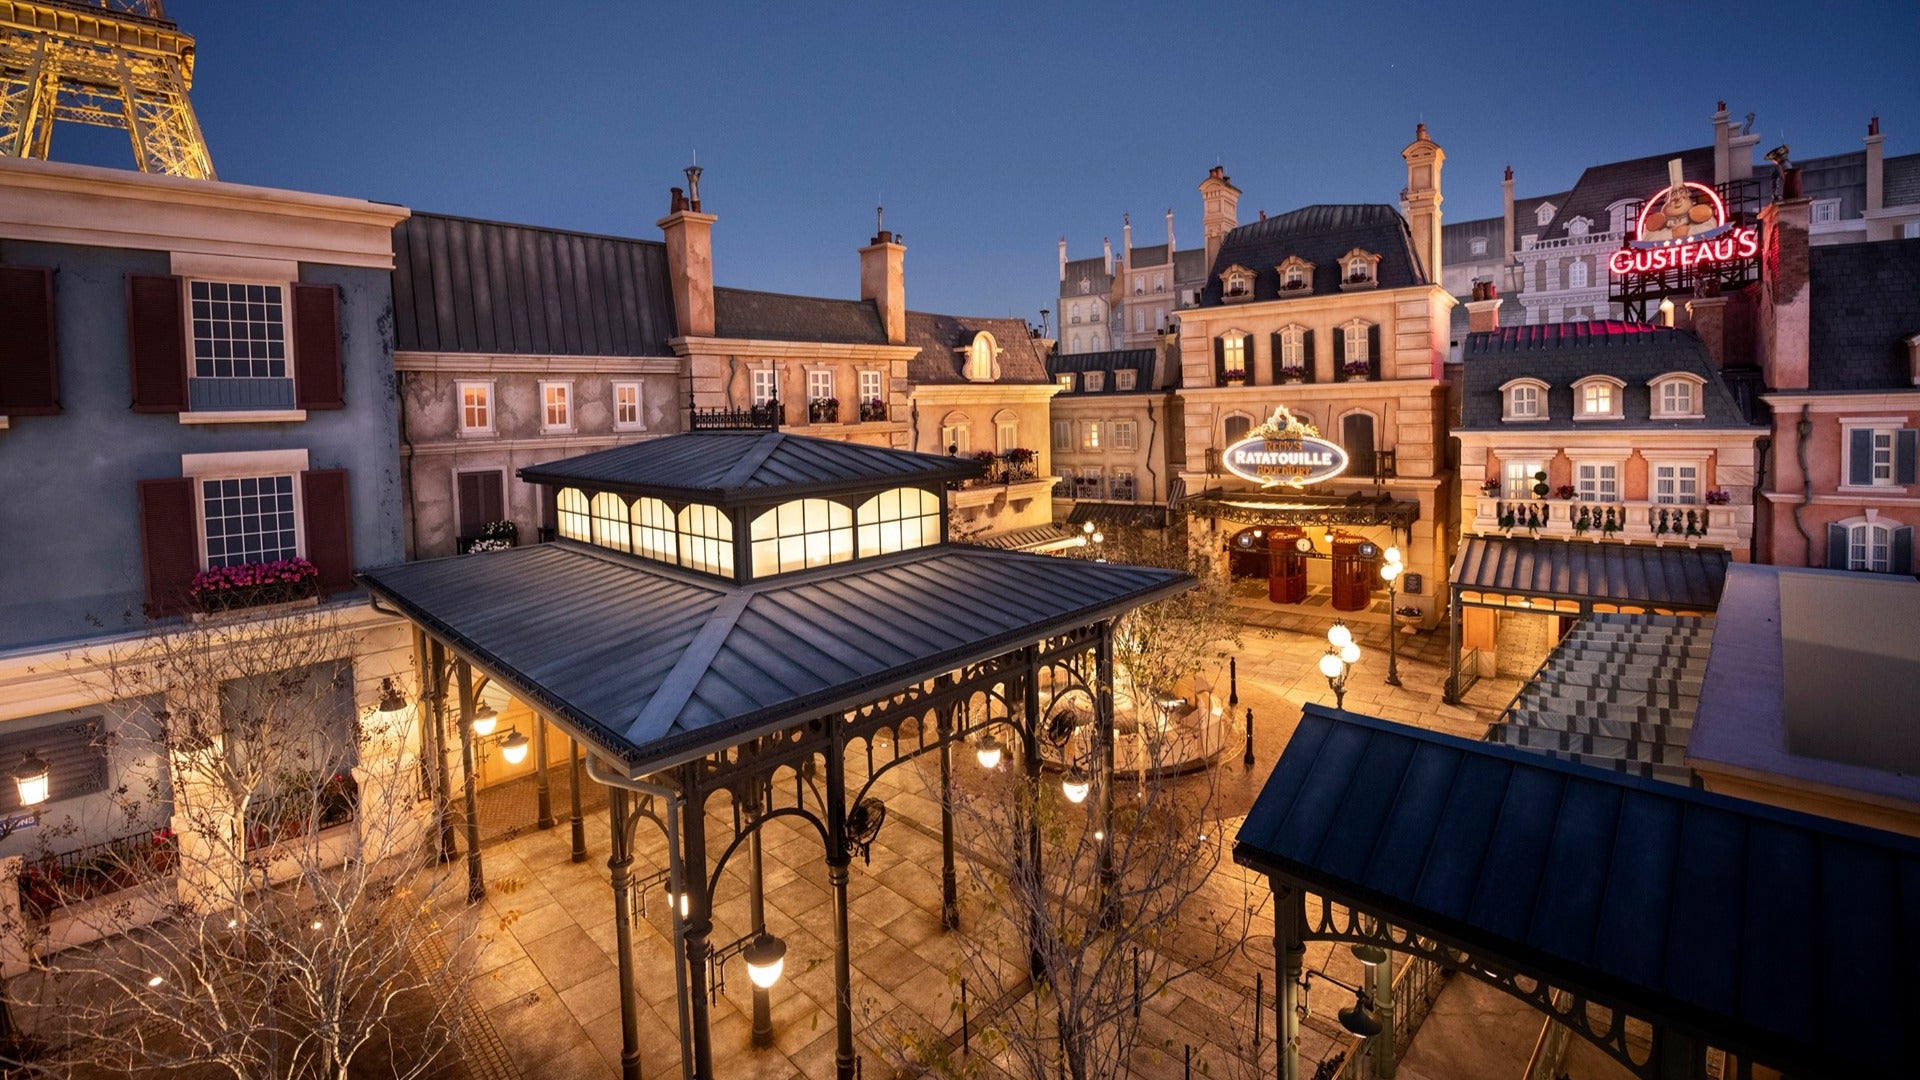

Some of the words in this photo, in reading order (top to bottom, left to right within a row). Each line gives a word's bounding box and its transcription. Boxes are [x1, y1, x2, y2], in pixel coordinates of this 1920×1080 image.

[1609, 229, 1757, 274] GUSTEAU'S
[1265, 442, 1302, 452] REMY'S
[1235, 451, 1332, 465] RATATOUILLE
[1256, 465, 1312, 477] ADVENTURE
